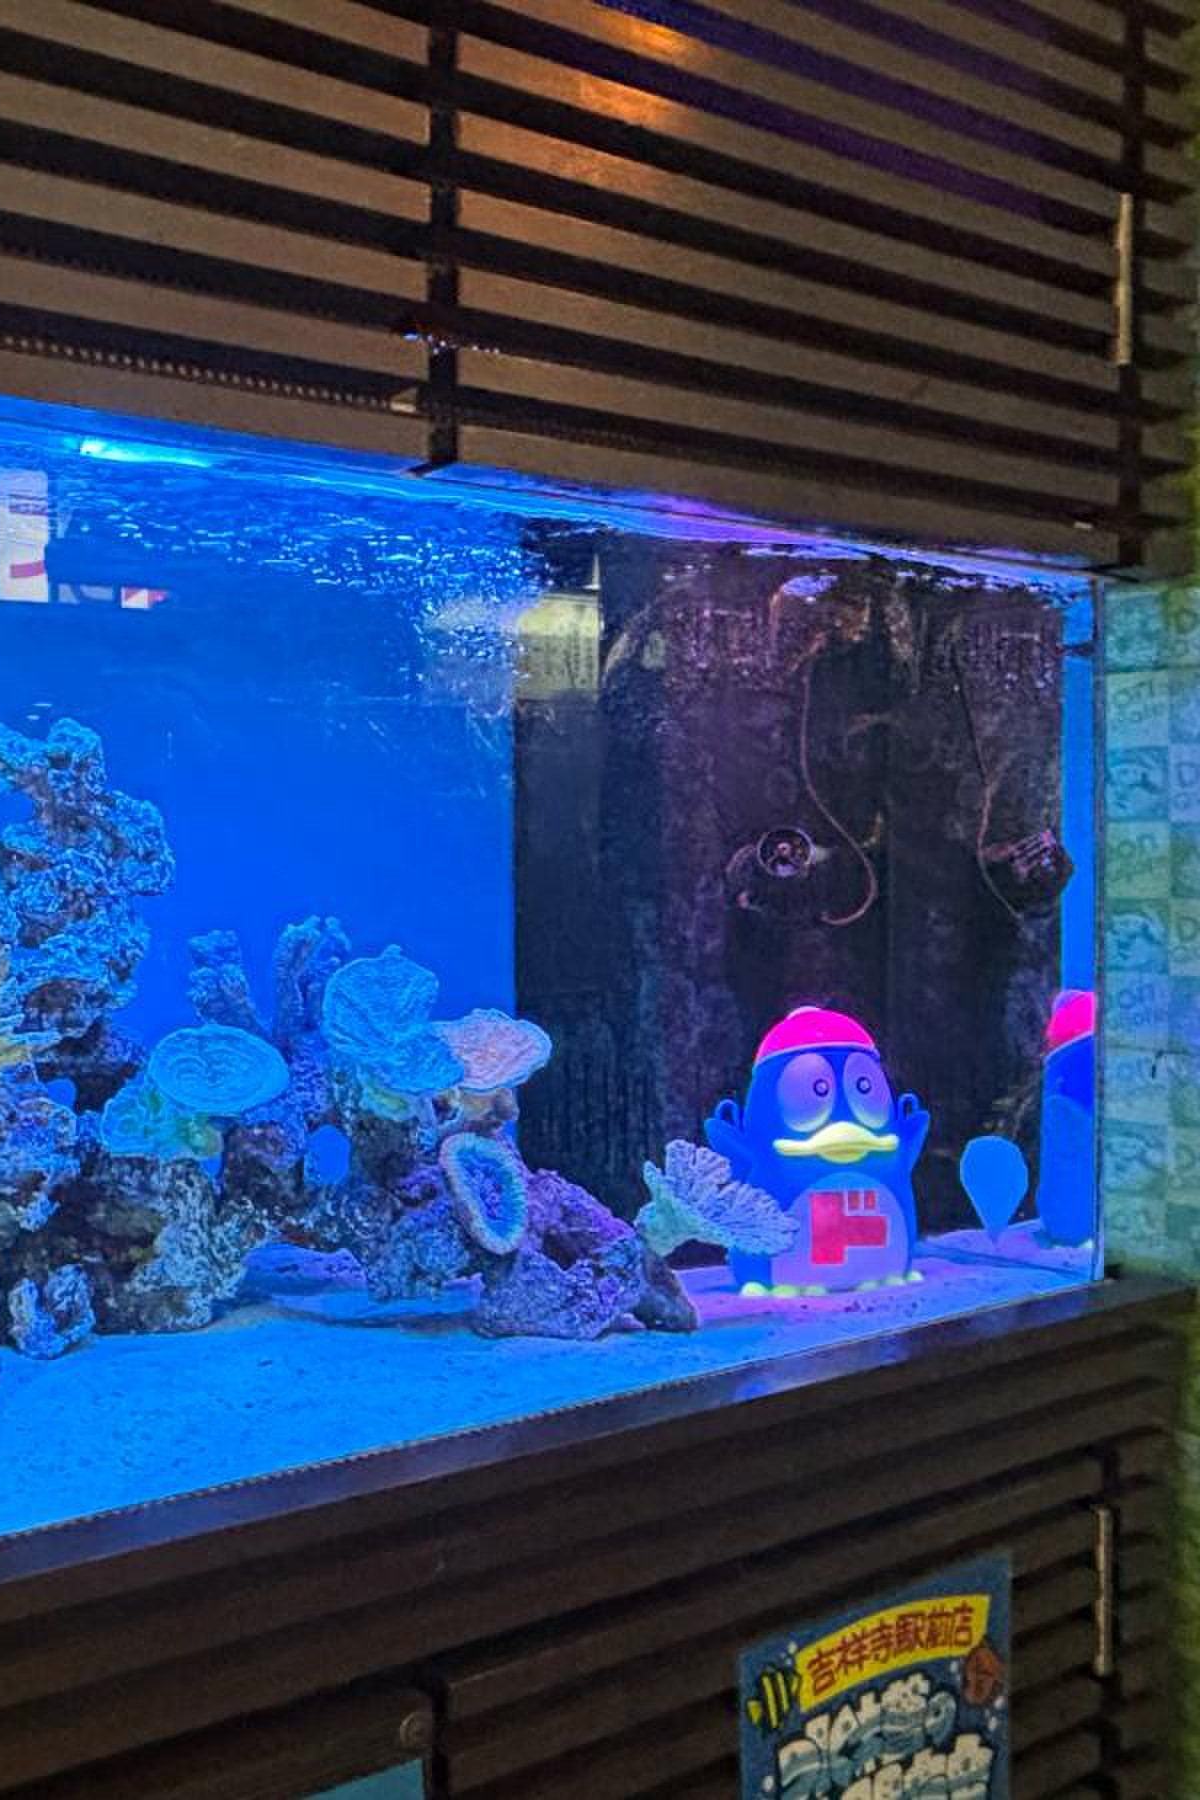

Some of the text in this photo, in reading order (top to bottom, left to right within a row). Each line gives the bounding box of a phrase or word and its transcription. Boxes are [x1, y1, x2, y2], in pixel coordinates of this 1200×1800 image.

[810, 1191, 888, 1264] ド
[806, 1601, 974, 1696] 吉祥寺駅前店
